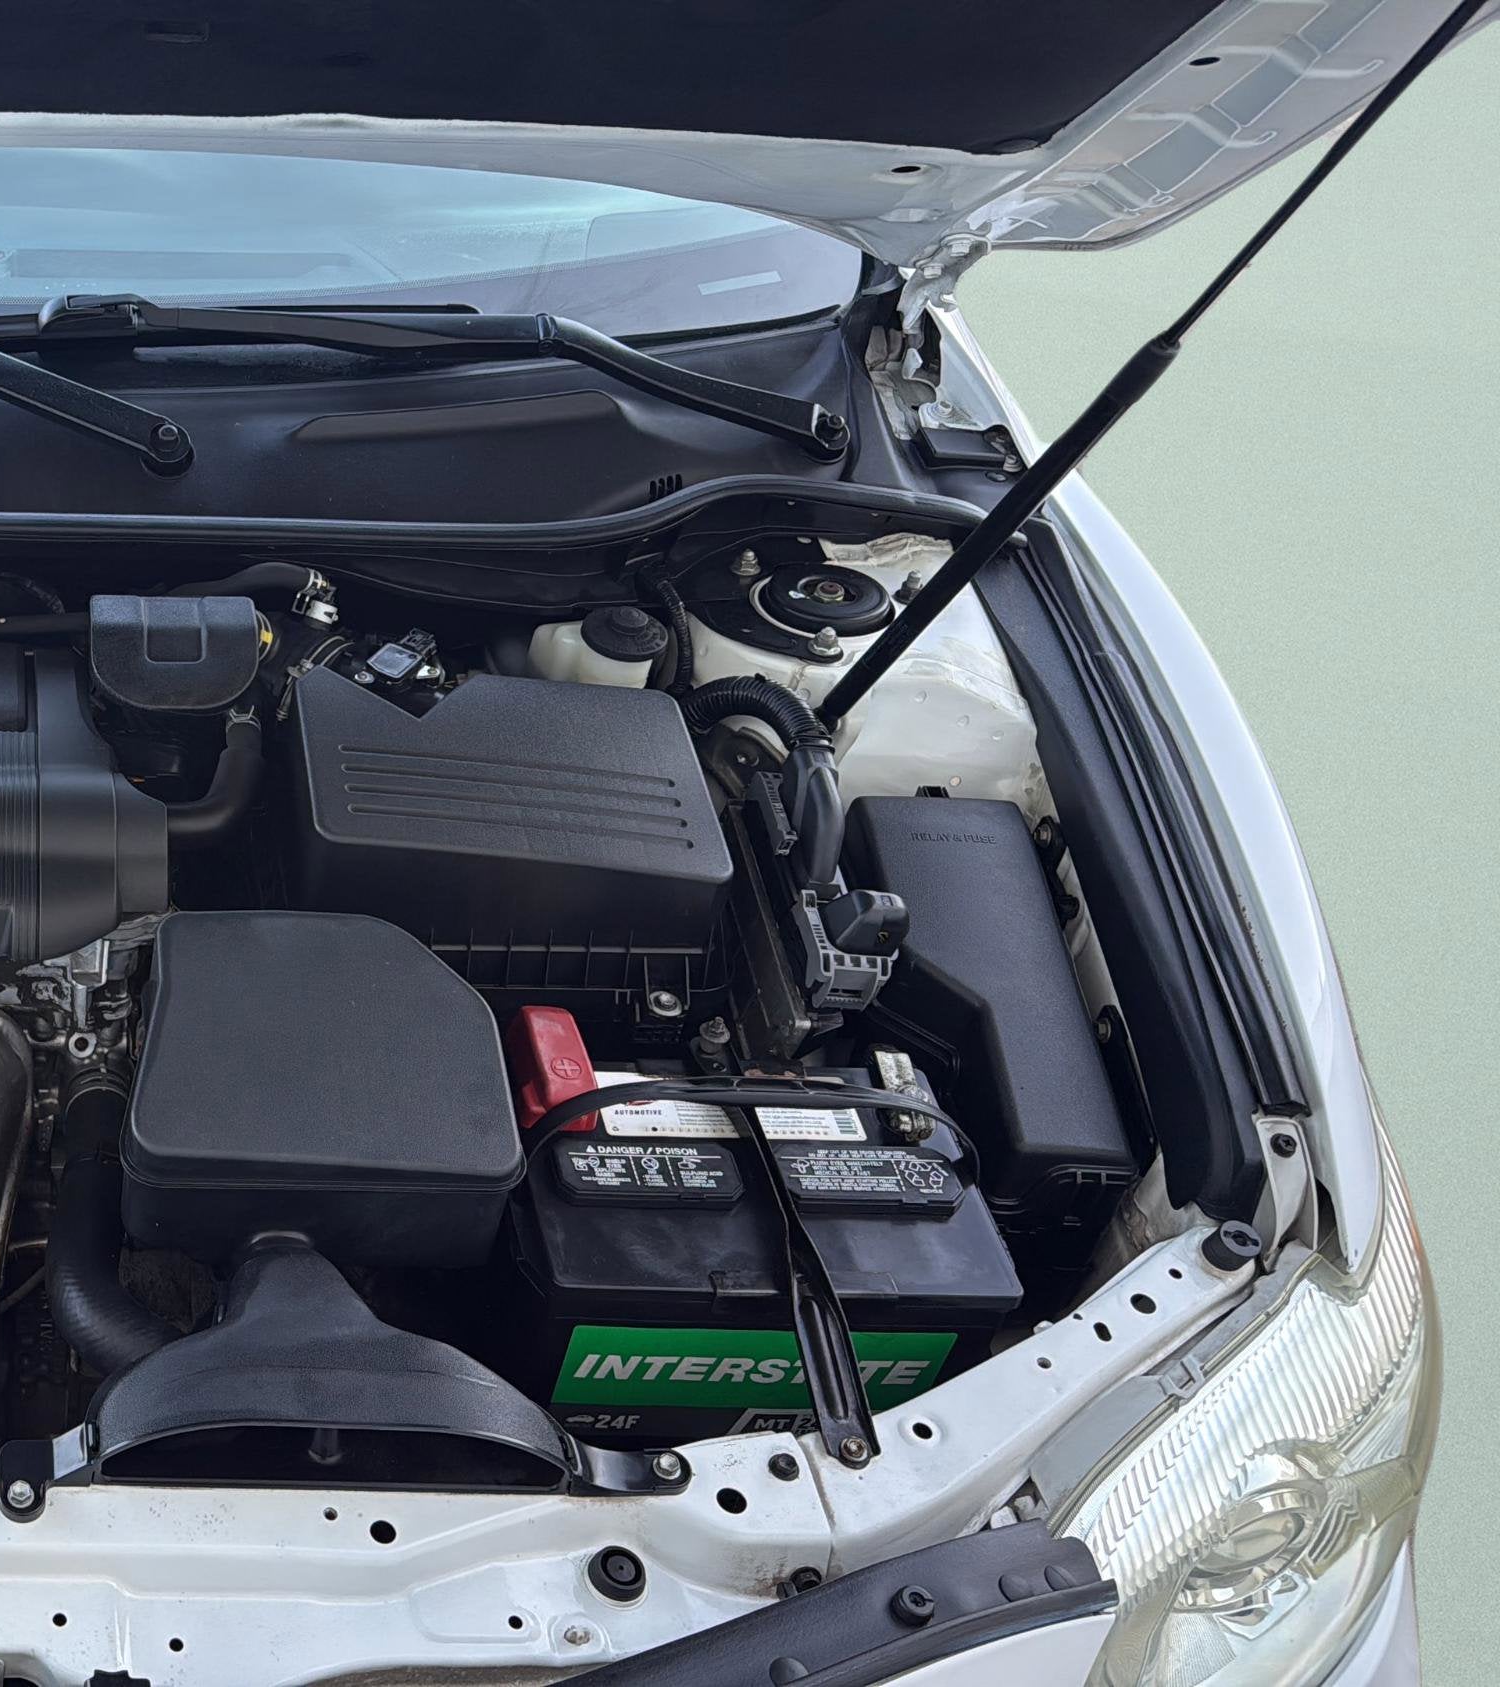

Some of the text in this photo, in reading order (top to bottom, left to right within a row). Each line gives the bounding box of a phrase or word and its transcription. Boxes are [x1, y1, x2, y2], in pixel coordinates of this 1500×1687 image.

[910, 832, 950, 842] RELAY
[963, 833, 997, 844] FUSE
[597, 1145, 644, 1154] DANGER
[655, 1147, 698, 1156] POISON
[573, 1354, 931, 1385] INTERSTE
[594, 1414, 641, 1430] 24F
[754, 1418, 791, 1430] MT
